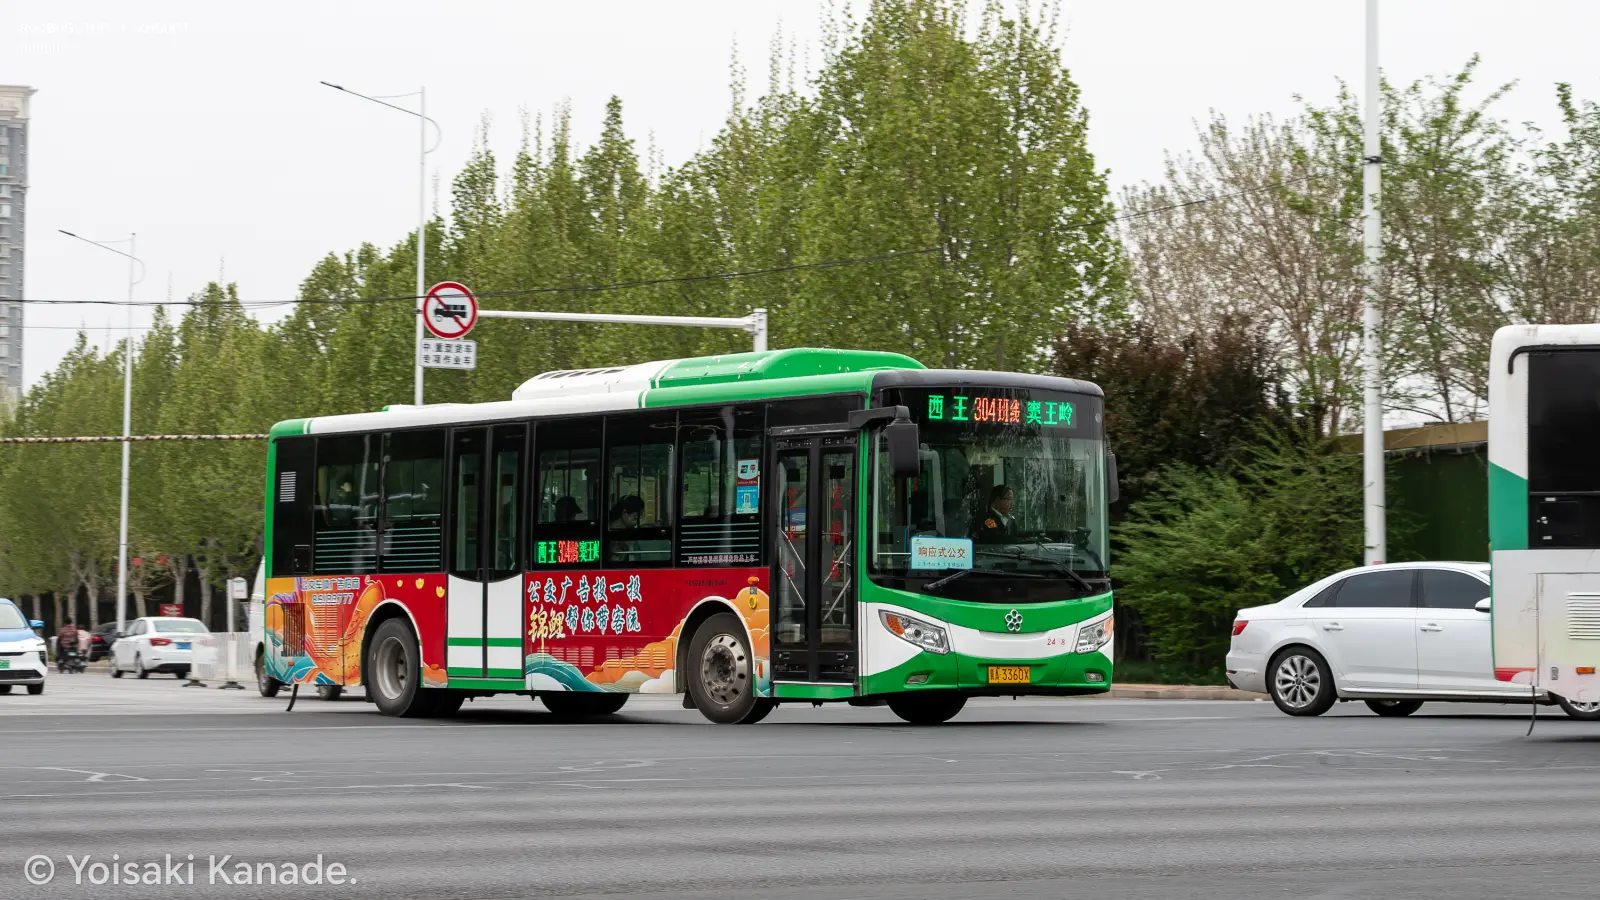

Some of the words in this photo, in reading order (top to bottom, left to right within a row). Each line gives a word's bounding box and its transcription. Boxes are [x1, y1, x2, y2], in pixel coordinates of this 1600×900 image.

[917, 546, 966, 559] 响应式公交
[527, 574, 643, 605] 公交广告投一投
